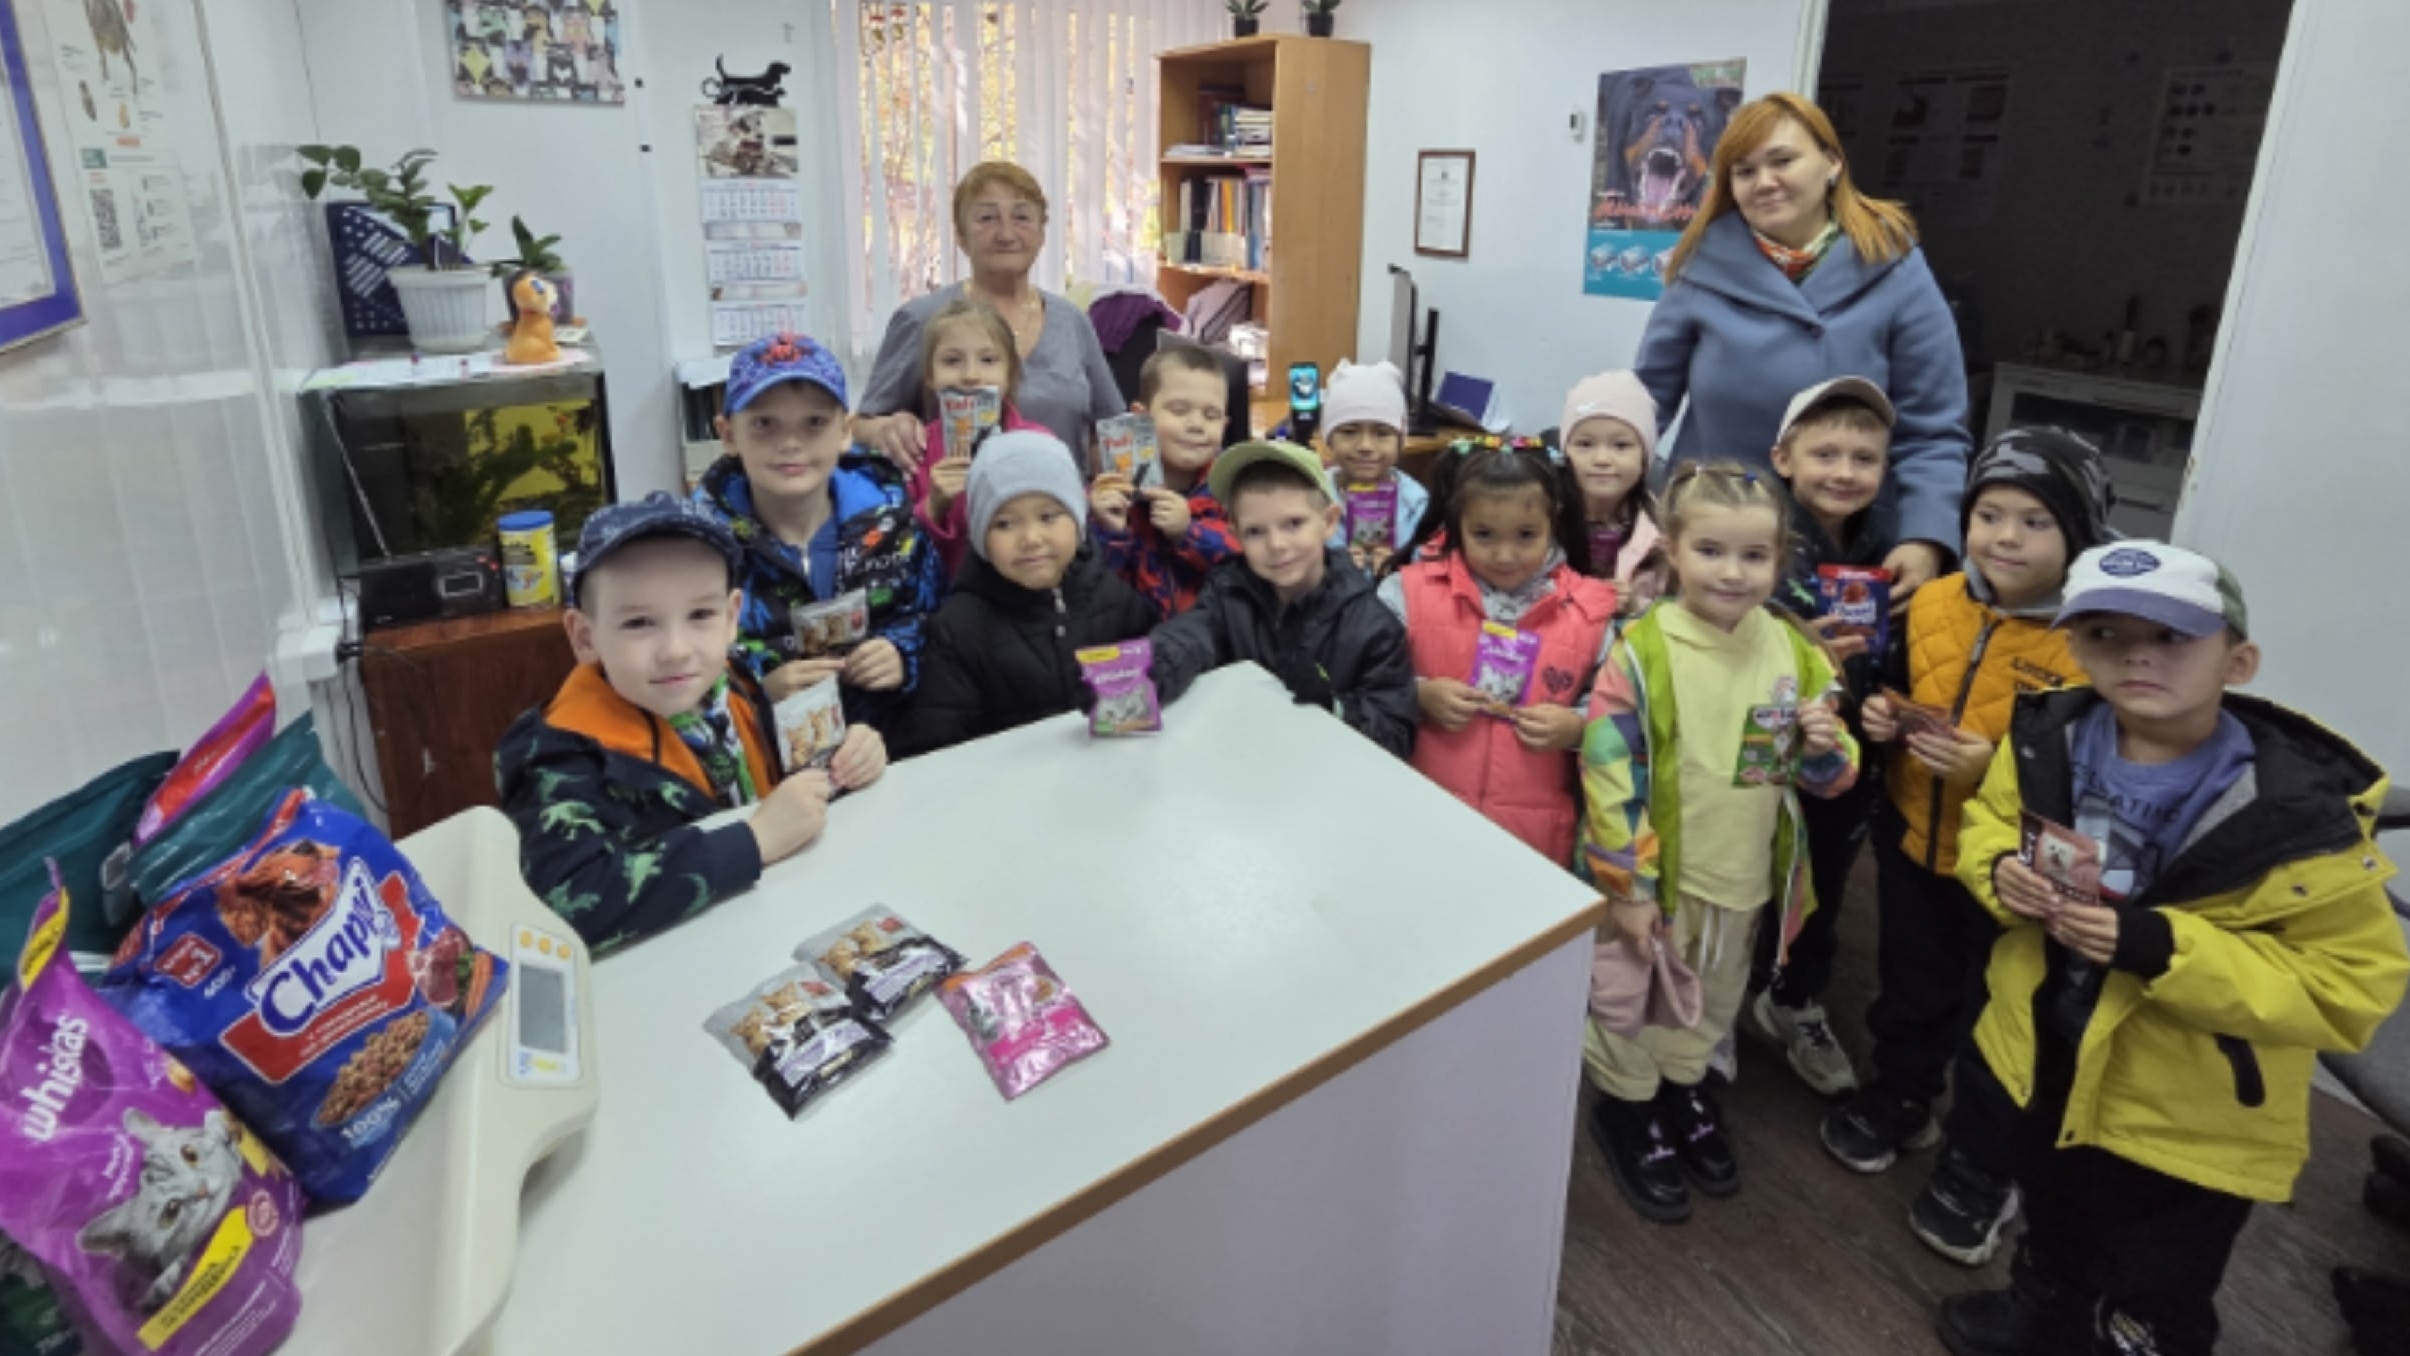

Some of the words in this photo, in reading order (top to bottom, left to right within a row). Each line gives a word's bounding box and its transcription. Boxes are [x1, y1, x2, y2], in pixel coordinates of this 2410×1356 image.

[260, 874, 380, 1035] Chappi
[20, 1014, 88, 1141] whiskas
[341, 1096, 400, 1139] 100%
